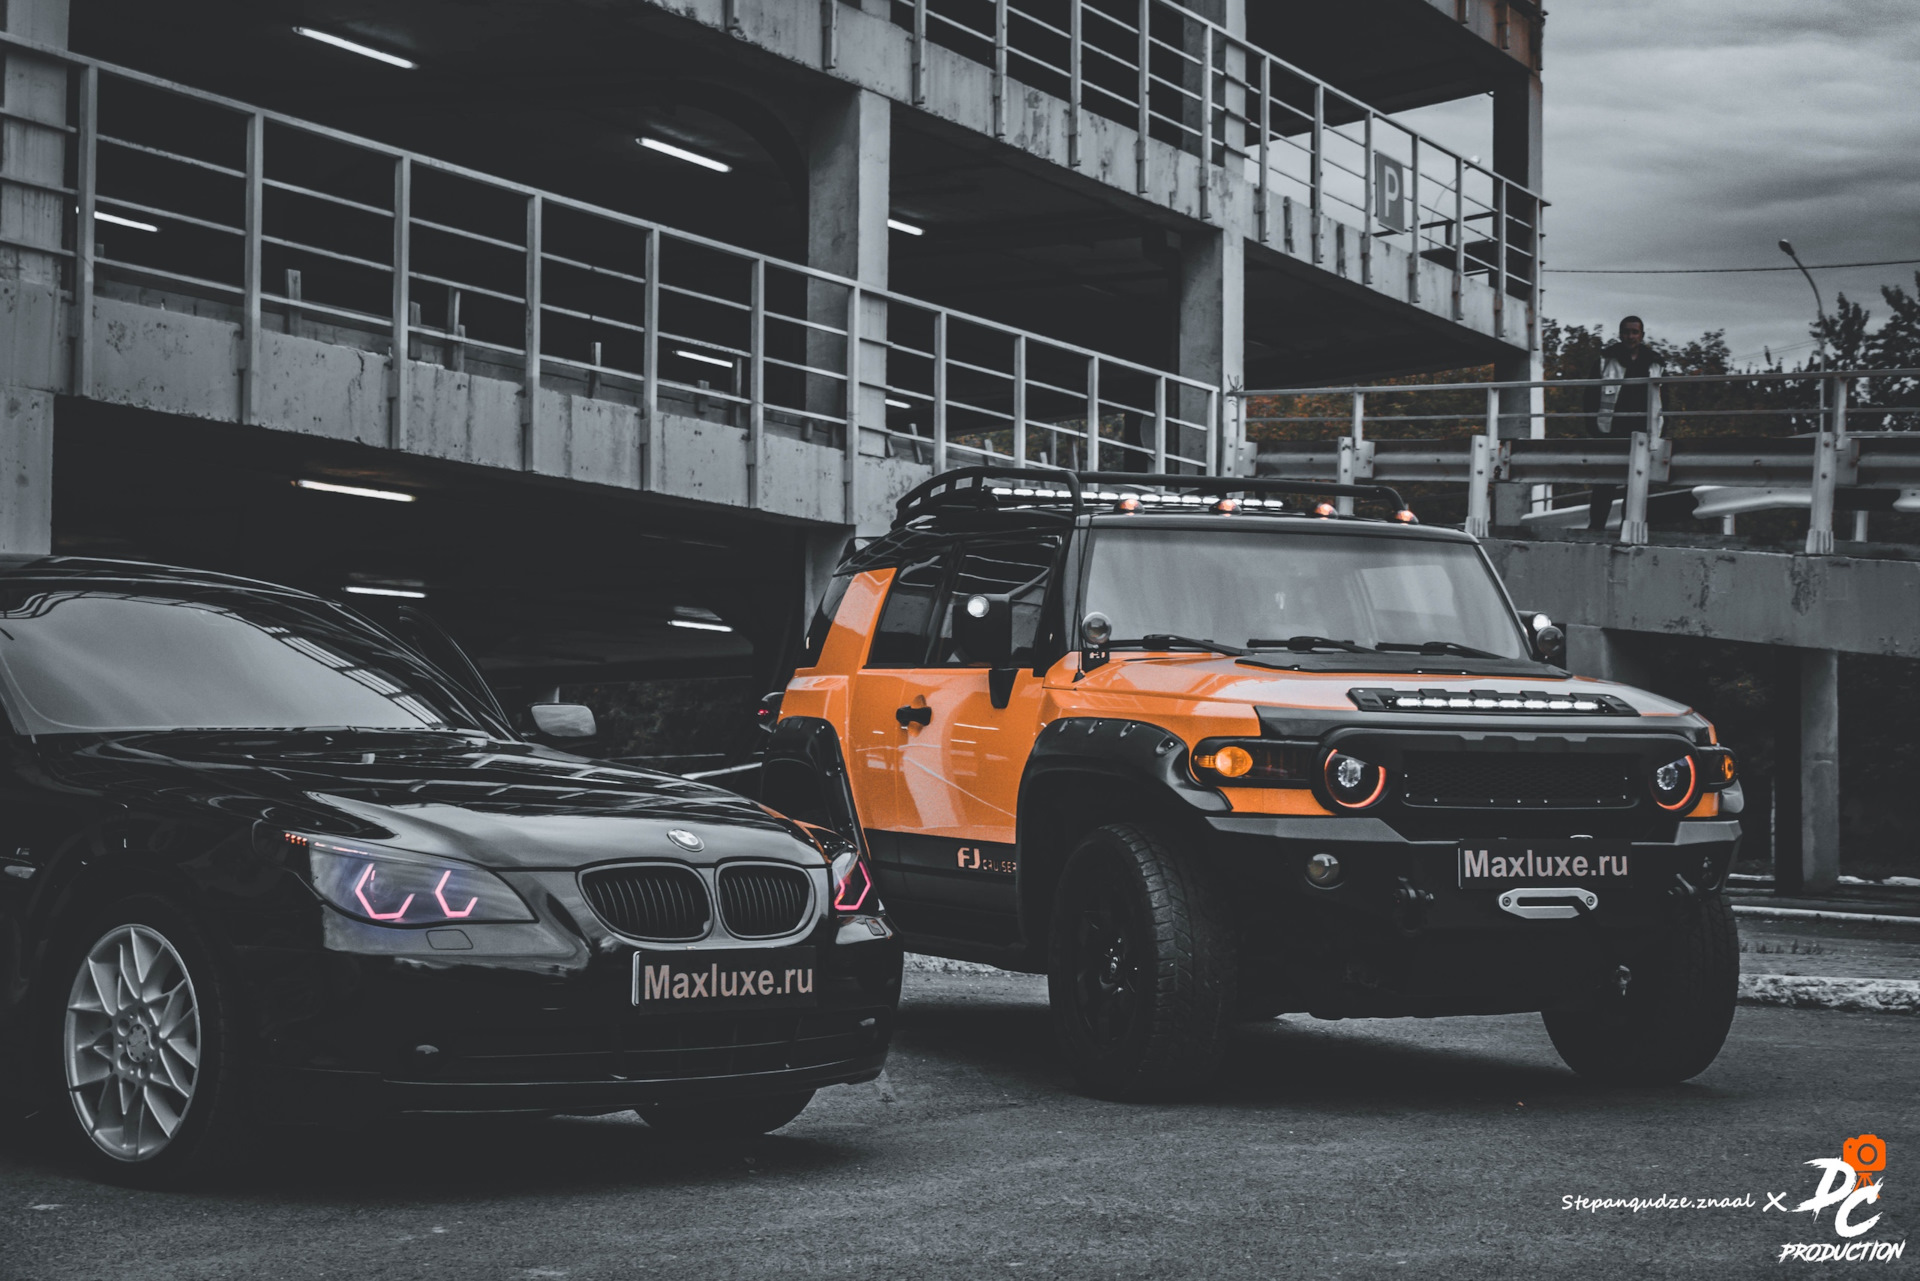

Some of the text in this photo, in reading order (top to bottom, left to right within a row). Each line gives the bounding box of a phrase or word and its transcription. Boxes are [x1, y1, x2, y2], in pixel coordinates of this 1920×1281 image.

[1384, 165, 1400, 218] P
[957, 847, 1017, 873] FJ CRUSER
[1463, 849, 1629, 878] Maxluxe.ru
[644, 963, 813, 1000] Maxluxe.ru
